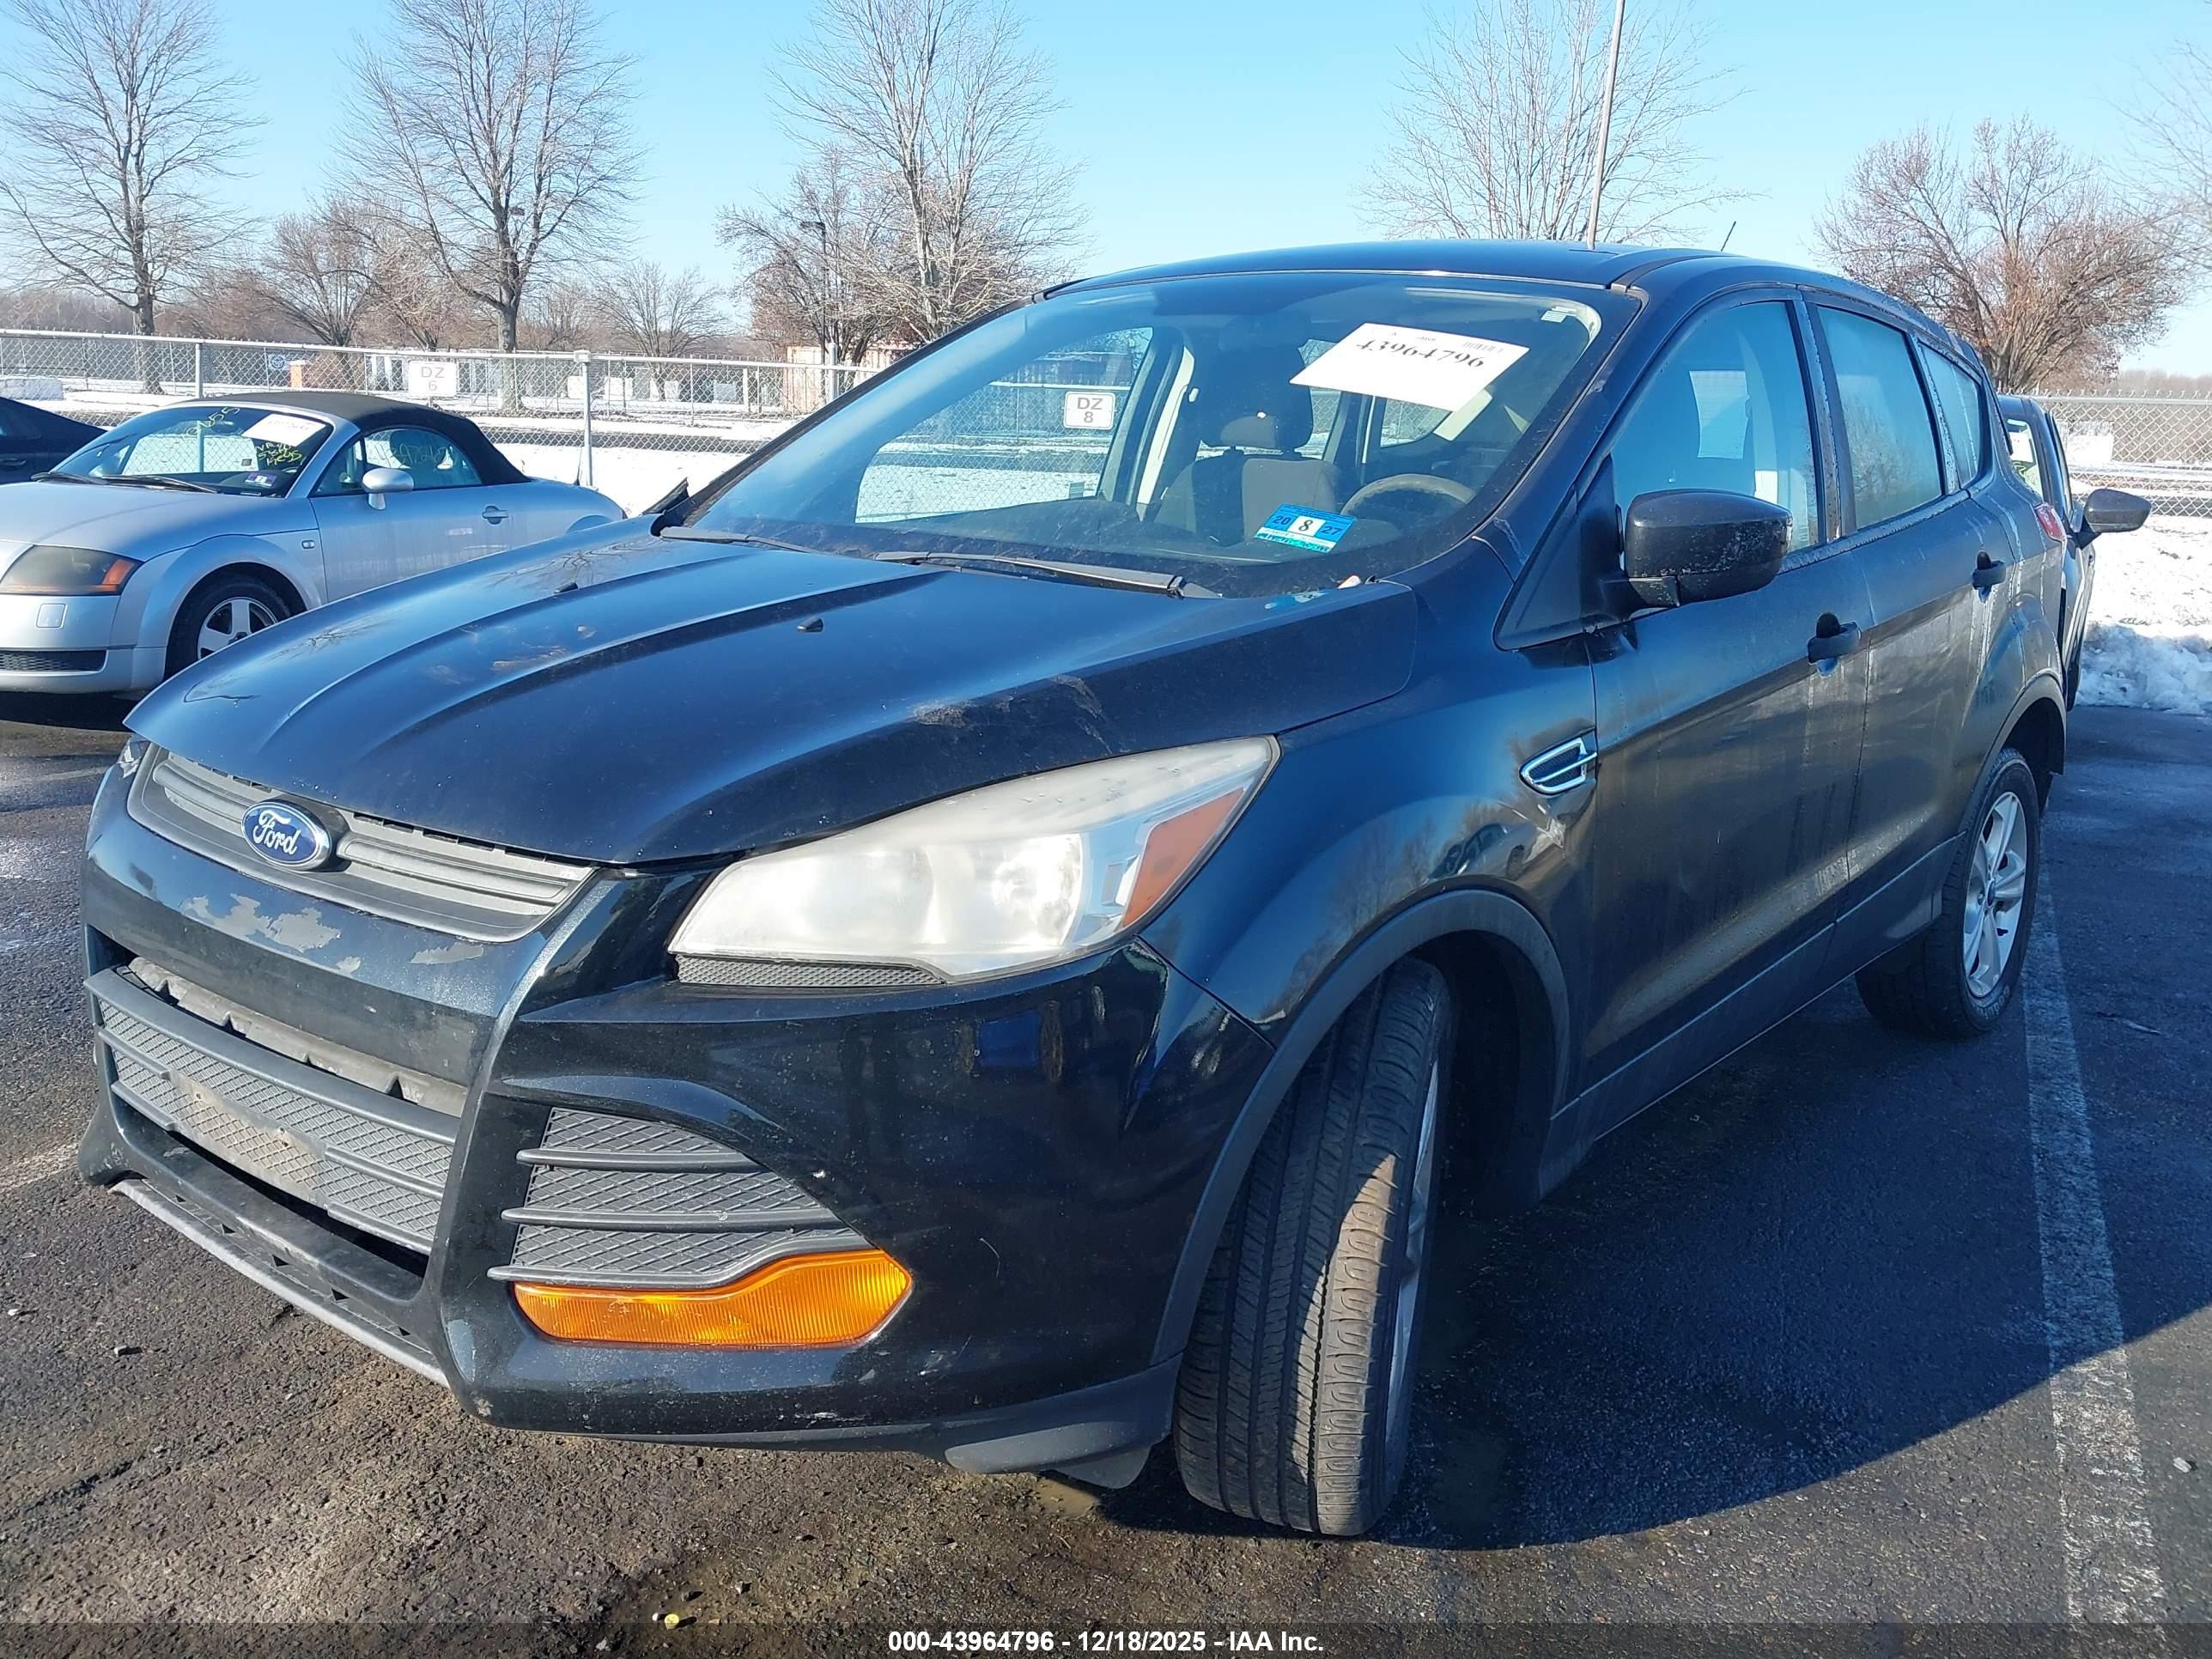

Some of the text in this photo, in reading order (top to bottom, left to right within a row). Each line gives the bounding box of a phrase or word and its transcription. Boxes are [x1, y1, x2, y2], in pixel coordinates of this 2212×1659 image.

[1356, 339, 1484, 368] 43964796
[421, 366, 446, 379] DZ
[428, 380, 438, 392] 6
[1077, 397, 1103, 410] DZ
[1083, 411, 1094, 423] 8
[1273, 515, 1292, 526] 20
[1297, 520, 1314, 532] 8
[1321, 526, 1343, 537] 27
[252, 810, 301, 855] Ford
